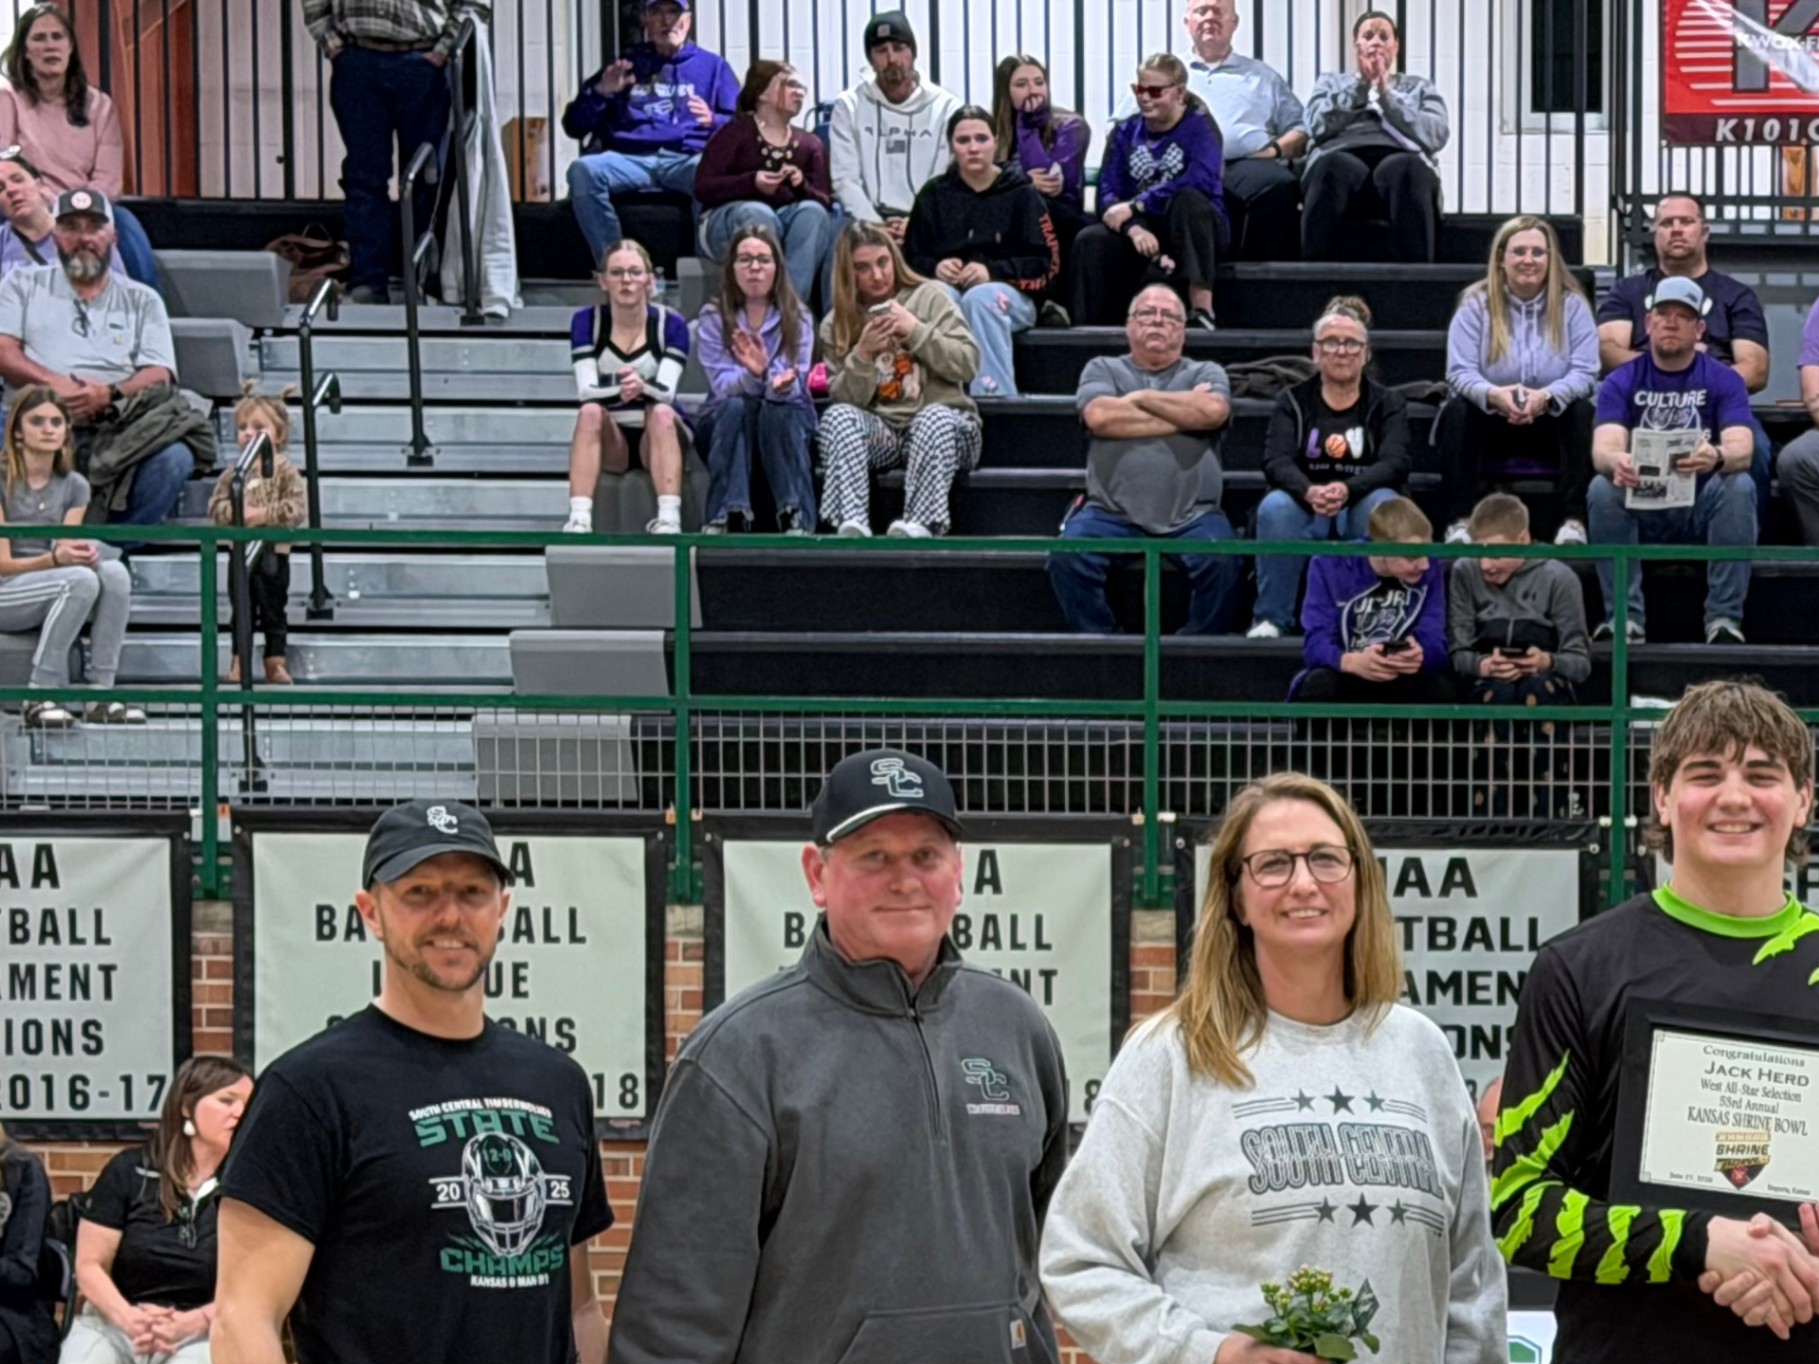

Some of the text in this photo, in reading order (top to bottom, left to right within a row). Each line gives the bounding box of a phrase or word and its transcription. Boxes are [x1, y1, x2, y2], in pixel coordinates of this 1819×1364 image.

[1634, 389, 1707, 407] CULTURE
[1703, 1045, 1805, 1067] Congratulations
[1700, 1077, 1802, 1102] West All-Star Selection
[408, 1104, 442, 1121] SOUTH
[441, 1098, 484, 1113] CENTRAL
[1719, 1095, 1779, 1114] 53rd Annual
[414, 1109, 560, 1148] STATE
[1688, 1106, 1730, 1125] KANSAS
[1731, 1111, 1772, 1131] SHRINE
[1774, 1117, 1808, 1137] BOWL
[1716, 1143, 1770, 1156] SHRINE
[436, 1180, 571, 1202] 20 25
[439, 1244, 564, 1275] CHAMPS
